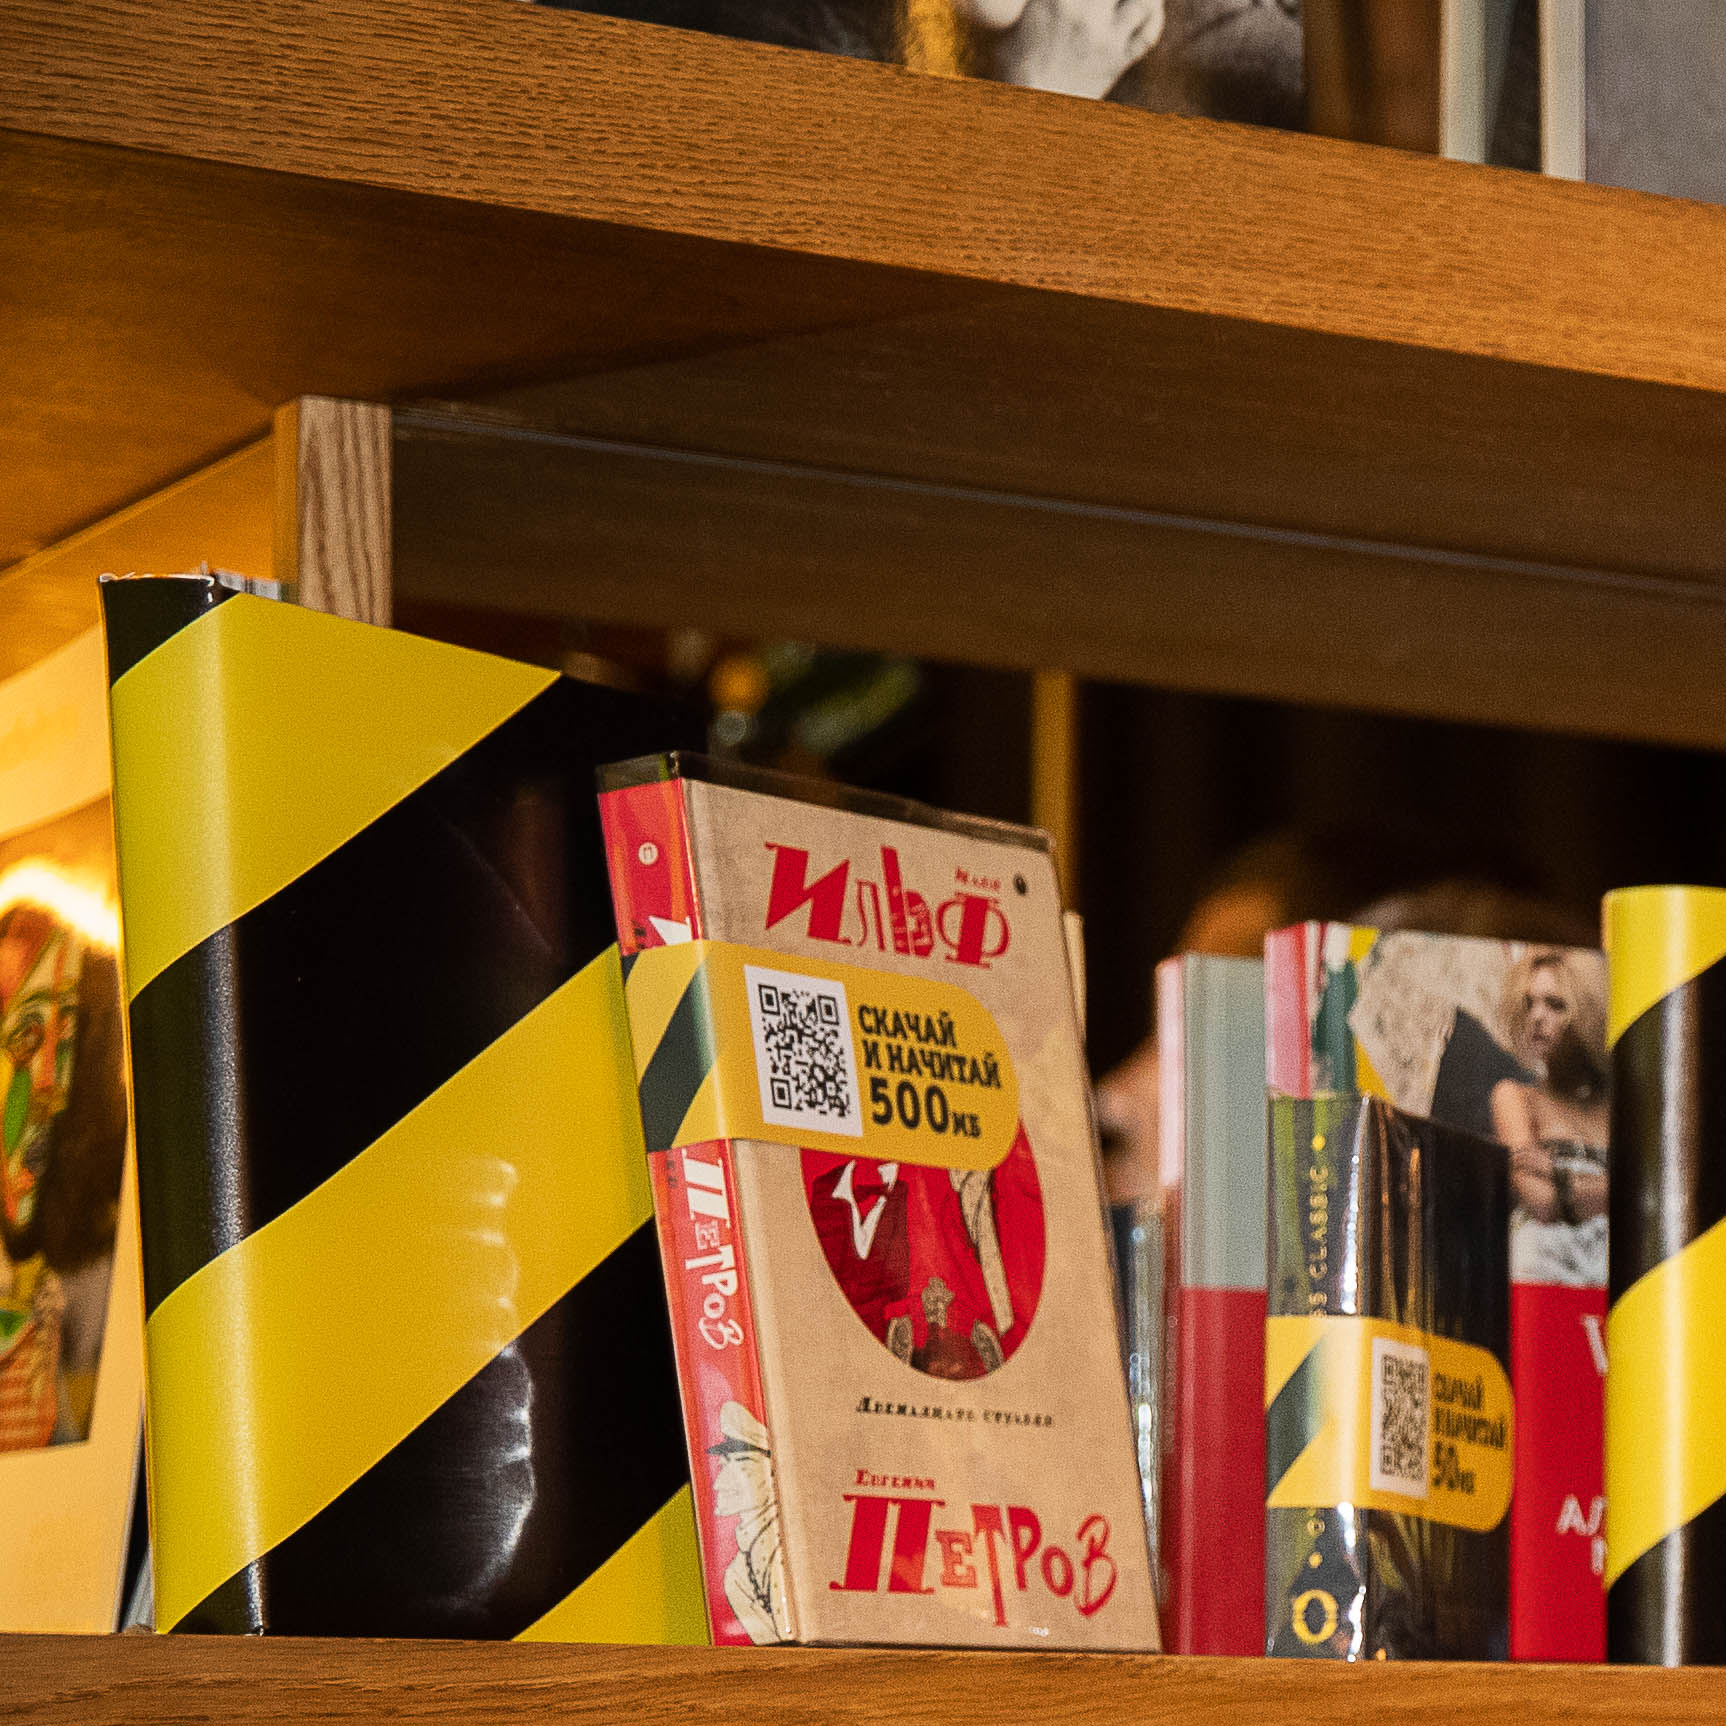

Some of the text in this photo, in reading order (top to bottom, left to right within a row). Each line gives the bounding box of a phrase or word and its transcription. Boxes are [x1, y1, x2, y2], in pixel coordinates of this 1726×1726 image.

[858, 1004, 957, 1048] СКАЧАЙ
[862, 1039, 1002, 1090] И НАЧИТАЙ
